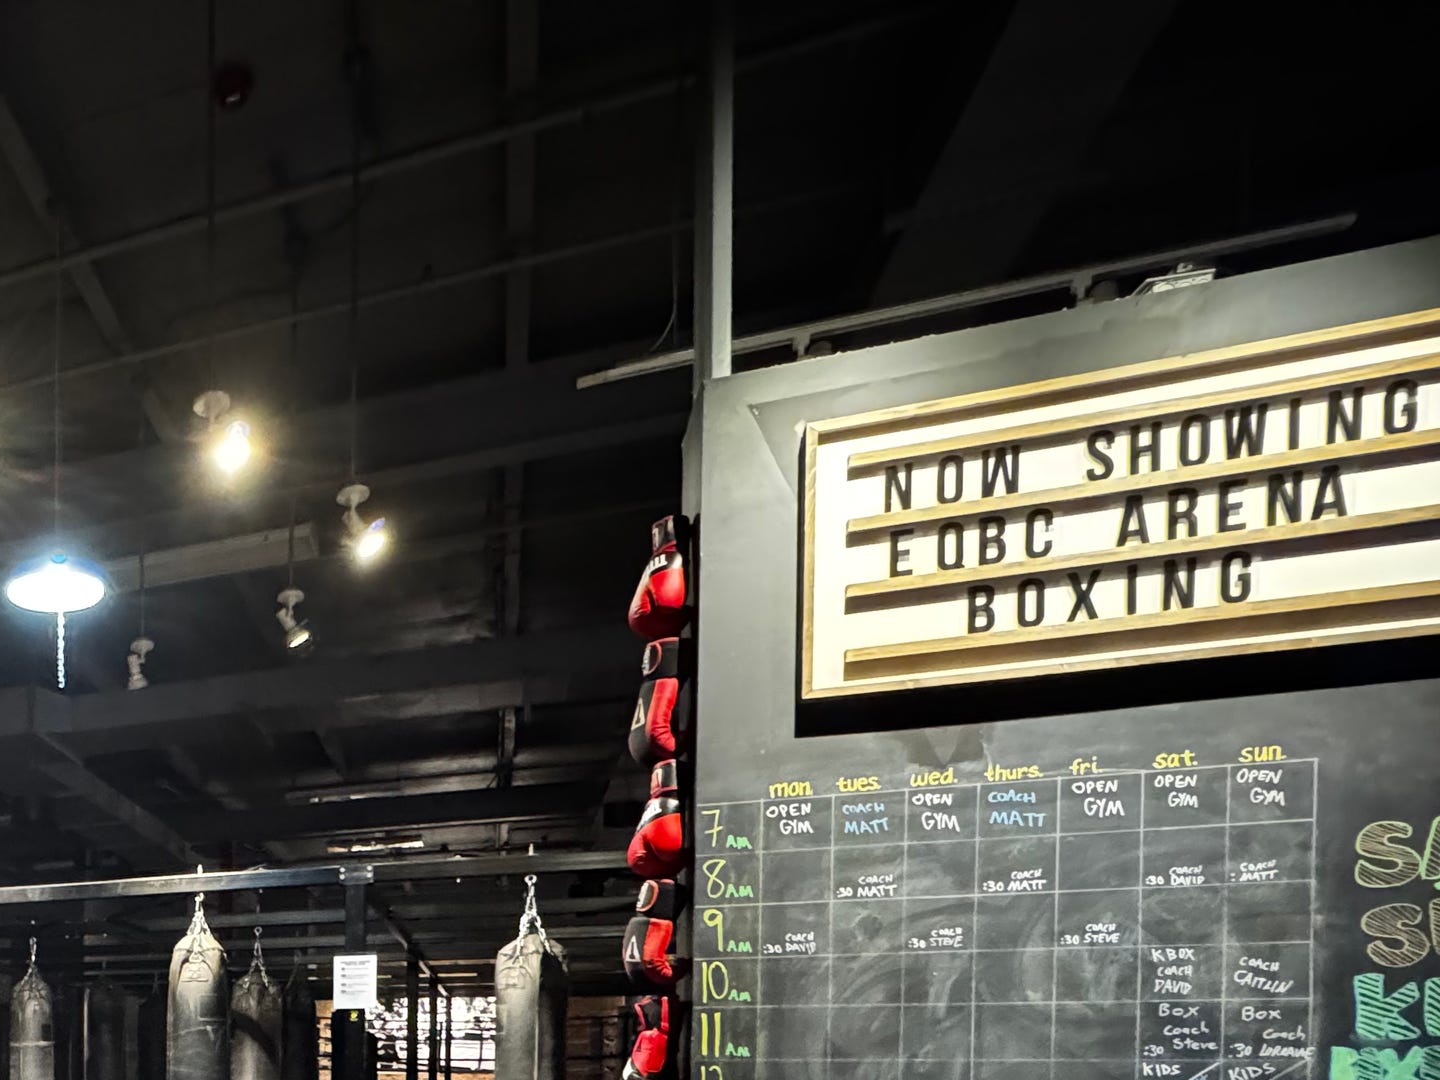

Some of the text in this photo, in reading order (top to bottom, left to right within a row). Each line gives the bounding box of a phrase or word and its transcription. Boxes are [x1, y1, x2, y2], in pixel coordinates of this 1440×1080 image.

[884, 378, 1419, 513] NOW SHOWING
[1117, 465, 1348, 547] ARENA
[967, 551, 1253, 635] BOXING
[1154, 774, 1198, 789] OPEN
[1236, 768, 1283, 785] OPEN
[1071, 780, 1118, 795] OPEN
[912, 793, 953, 807] OPEN
[988, 789, 1037, 804] COACH
[1168, 792, 1199, 809] GYM
[1249, 787, 1286, 806] GYM
[765, 803, 812, 819] OPEN
[842, 802, 885, 815] COACH
[1084, 797, 1125, 818] GYM
[779, 819, 814, 835] GYM
[844, 817, 889, 835] MATT
[921, 811, 960, 833] GYM
[989, 811, 1048, 828] MATT
[701, 809, 752, 849] 7 AM
[1169, 865, 1203, 876] COACH
[1240, 859, 1277, 871] COACH
[702, 859, 754, 898] 8 AM
[858, 875, 894, 885] COACH
[1010, 869, 1042, 879] COACH
[1240, 870, 1279, 881] MATT
[857, 885, 898, 898] MATT
[1008, 879, 1047, 892] MATT
[703, 909, 752, 953] 9 AM
[1083, 933, 1120, 945] STEVE
[1157, 965, 1193, 977] COACH
[1239, 957, 1280, 971] COACH
[702, 961, 729, 1003] 10
[1154, 979, 1192, 996] DAVID
[701, 1012, 721, 1058] 11
[1142, 1062, 1182, 1077] KIDS
